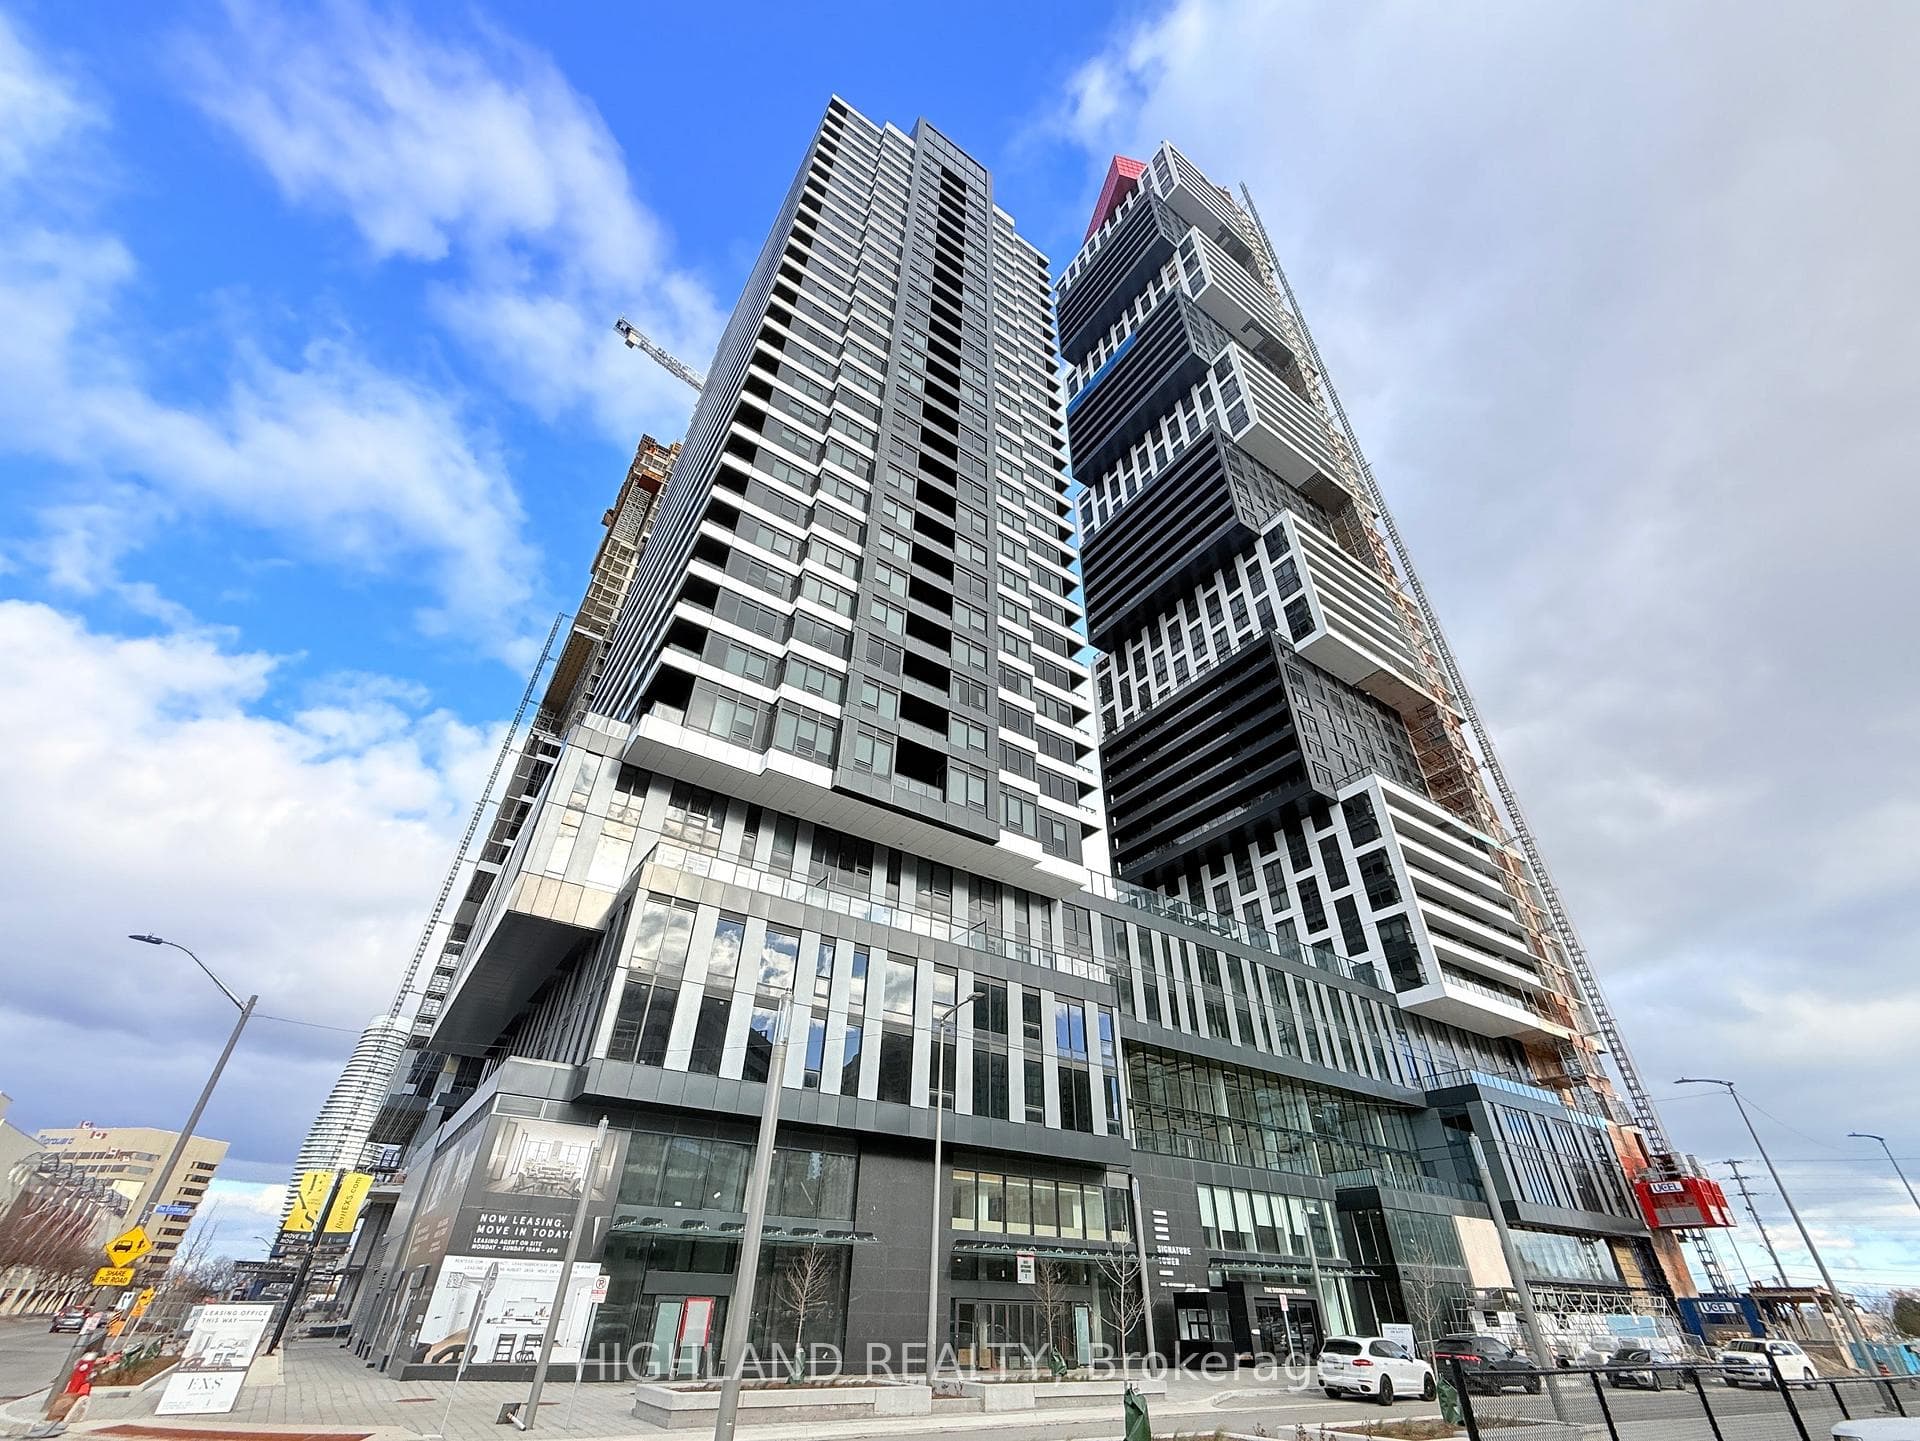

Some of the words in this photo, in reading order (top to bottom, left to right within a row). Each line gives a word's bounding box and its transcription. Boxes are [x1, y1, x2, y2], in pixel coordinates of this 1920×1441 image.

[480, 1213, 508, 1224] NOW
[512, 1215, 565, 1228] LEASING.
[282, 1232, 300, 1240] MOVE
[476, 1224, 510, 1235] MOVE
[514, 1226, 528, 1236] IN
[532, 1228, 573, 1239] TODAY!
[1157, 1245, 1192, 1256] SIGNATURE
[1158, 1256, 1180, 1266] TOWER
[110, 1276, 128, 1284] ROAD
